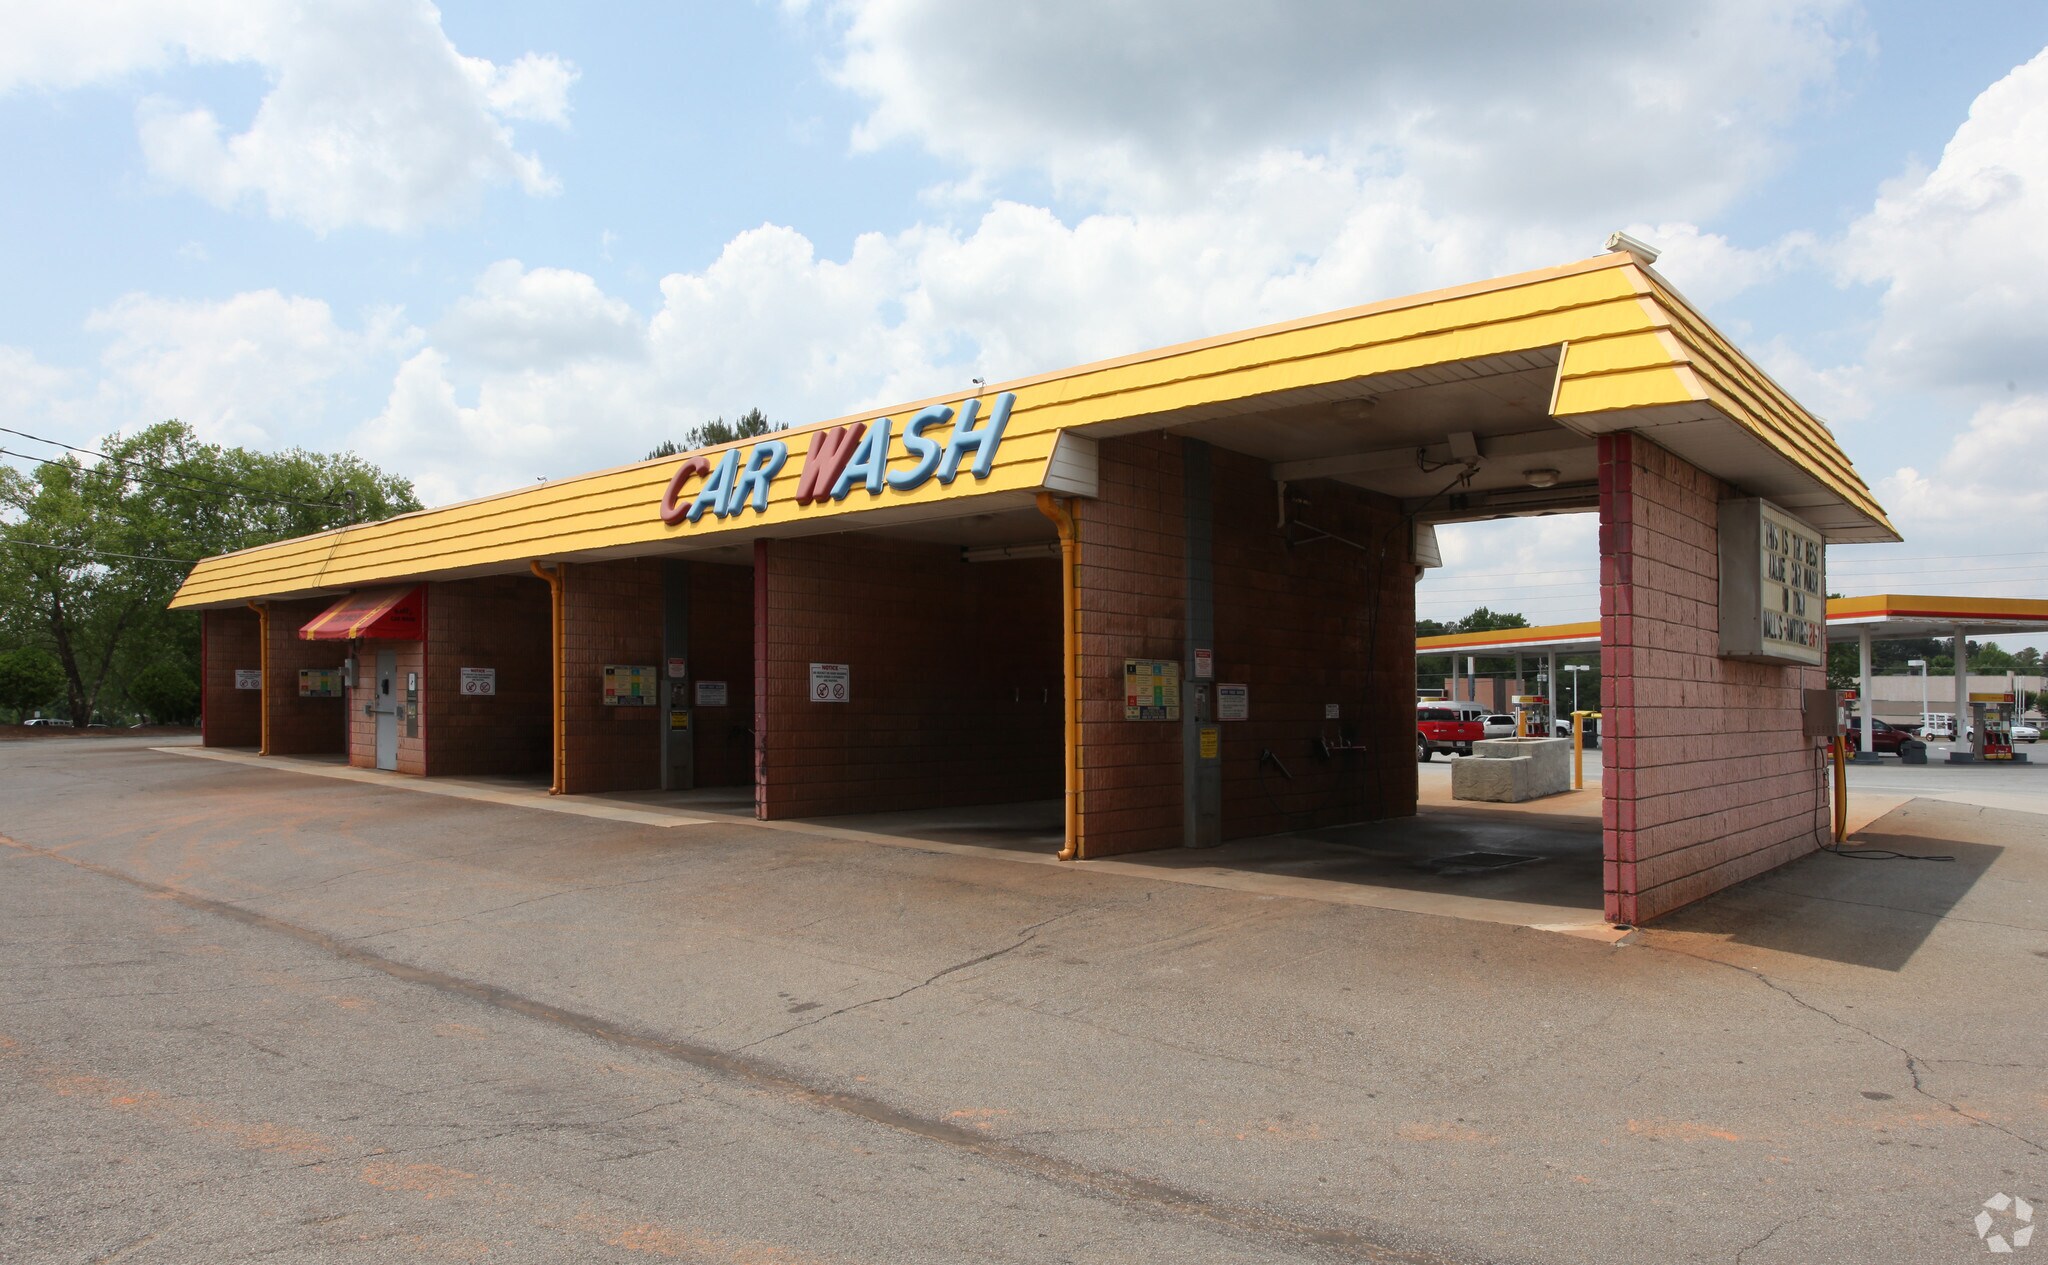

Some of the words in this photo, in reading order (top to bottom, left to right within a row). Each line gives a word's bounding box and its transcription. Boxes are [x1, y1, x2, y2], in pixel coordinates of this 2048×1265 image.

[660, 440, 788, 526] CAR
[796, 392, 1017, 506] WASH
[1782, 529, 1788, 555] IS
[1791, 562, 1801, 588] CAR
